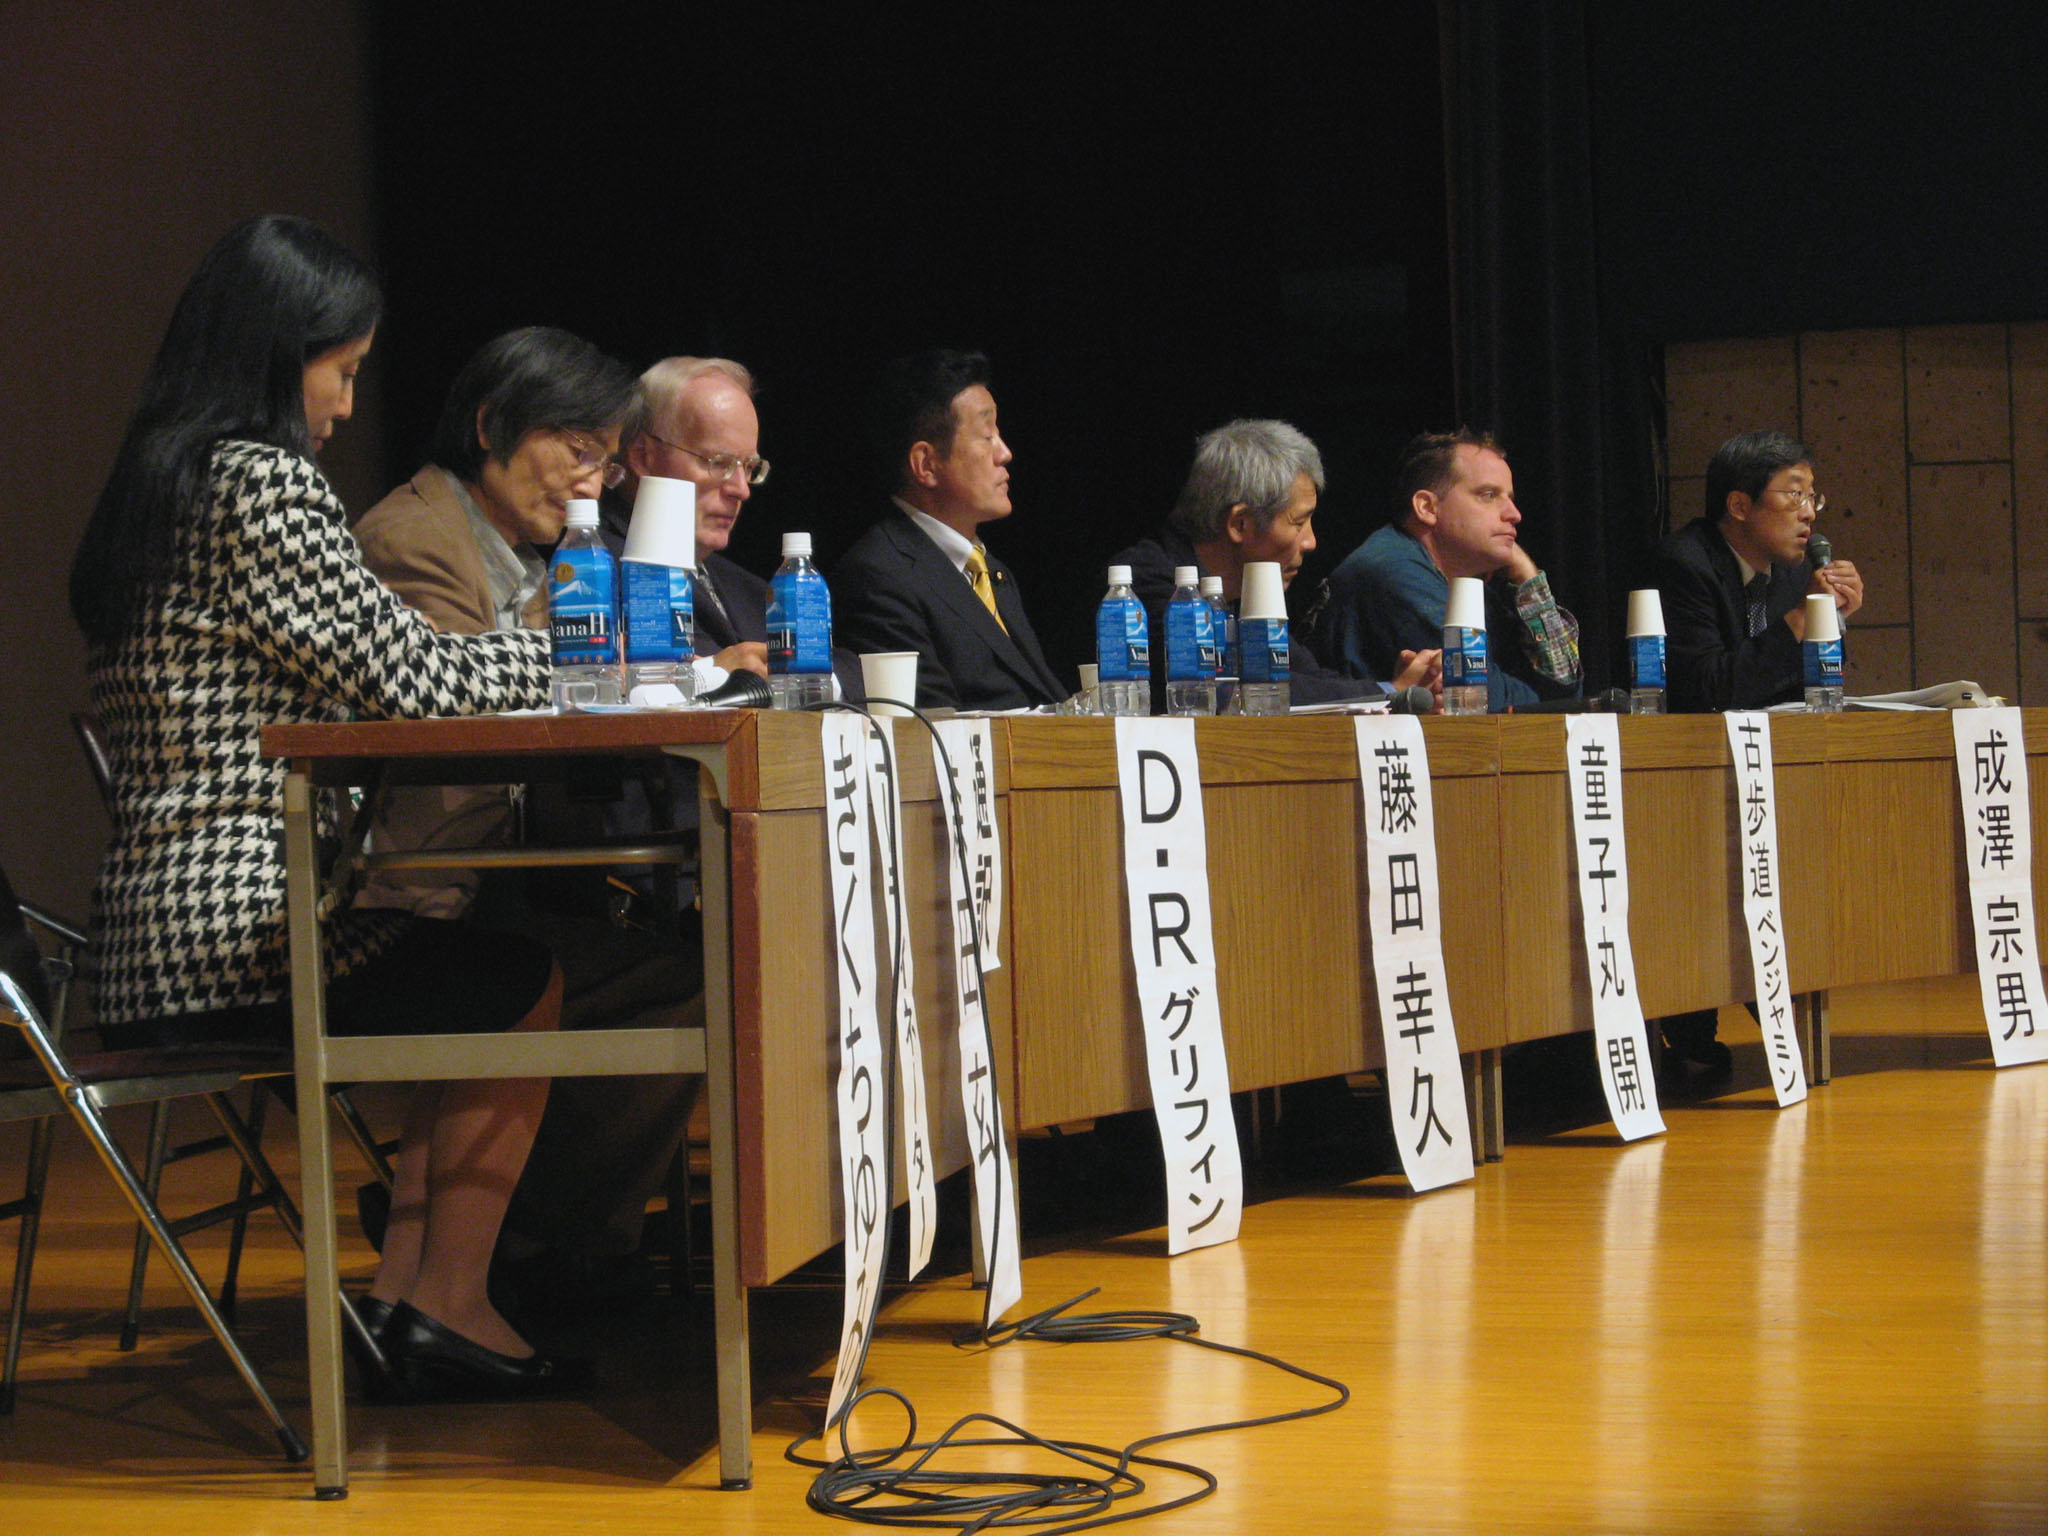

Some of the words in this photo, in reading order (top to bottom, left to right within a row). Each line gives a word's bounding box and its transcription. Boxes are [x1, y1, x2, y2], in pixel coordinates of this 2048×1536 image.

[833, 734, 878, 1389] きくちゆみ
[869, 729, 927, 1258] コーィネーター
[1374, 739, 1454, 1158] 藤田幸久
[1738, 717, 1797, 1094] 古歩道ベンジャミン
[1973, 728, 2036, 1042] 成澤宗男
